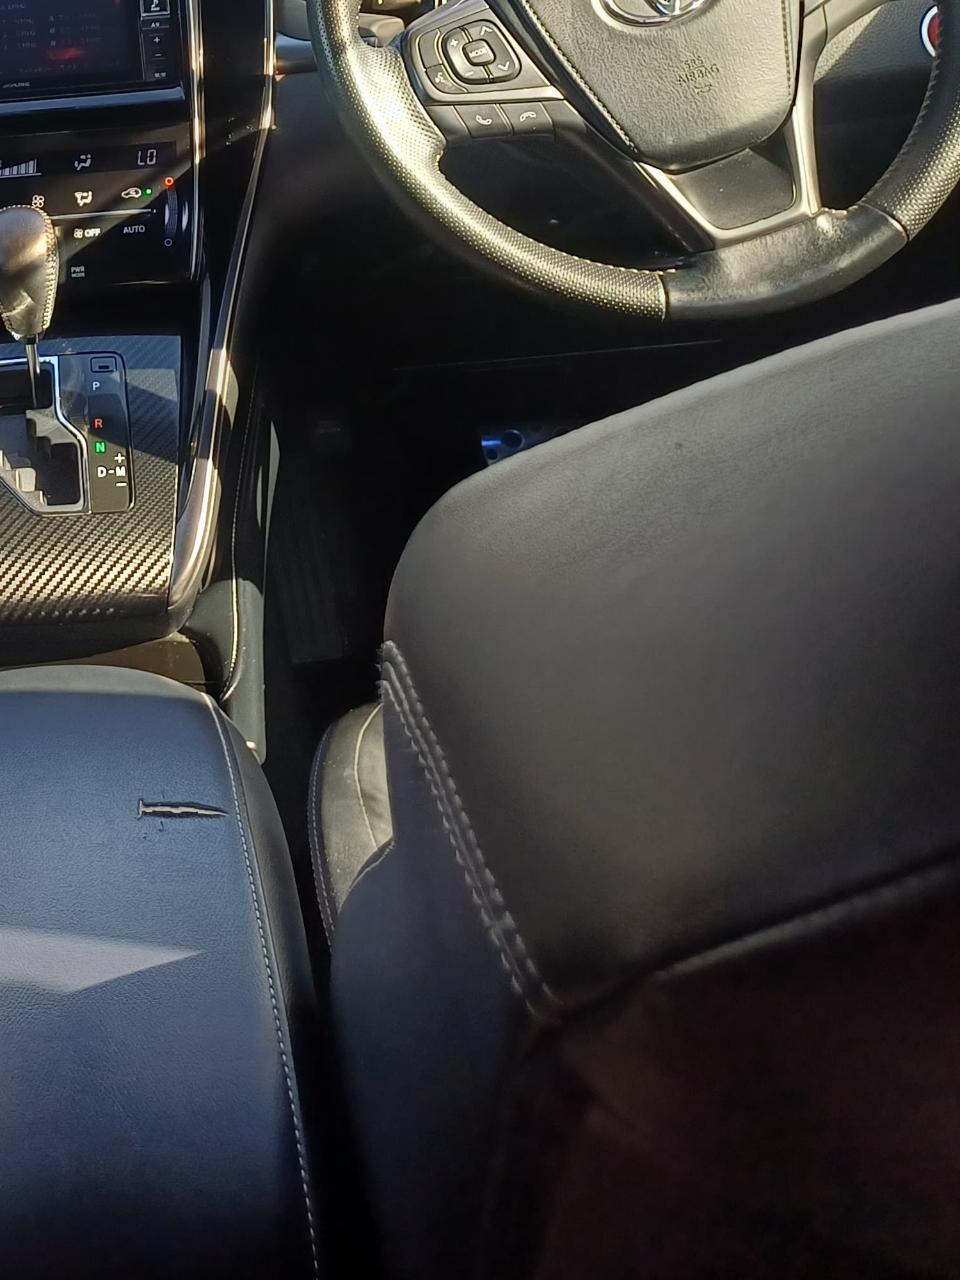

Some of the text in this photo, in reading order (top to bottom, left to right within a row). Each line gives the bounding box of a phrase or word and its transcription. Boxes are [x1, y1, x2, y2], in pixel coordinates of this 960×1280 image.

[84, 227, 101, 238] OFF
[123, 225, 145, 234] AUTO
[70, 265, 85, 273] PWR
[92, 381, 101, 391] P
[95, 418, 103, 428] R
[95, 442, 106, 453] N
